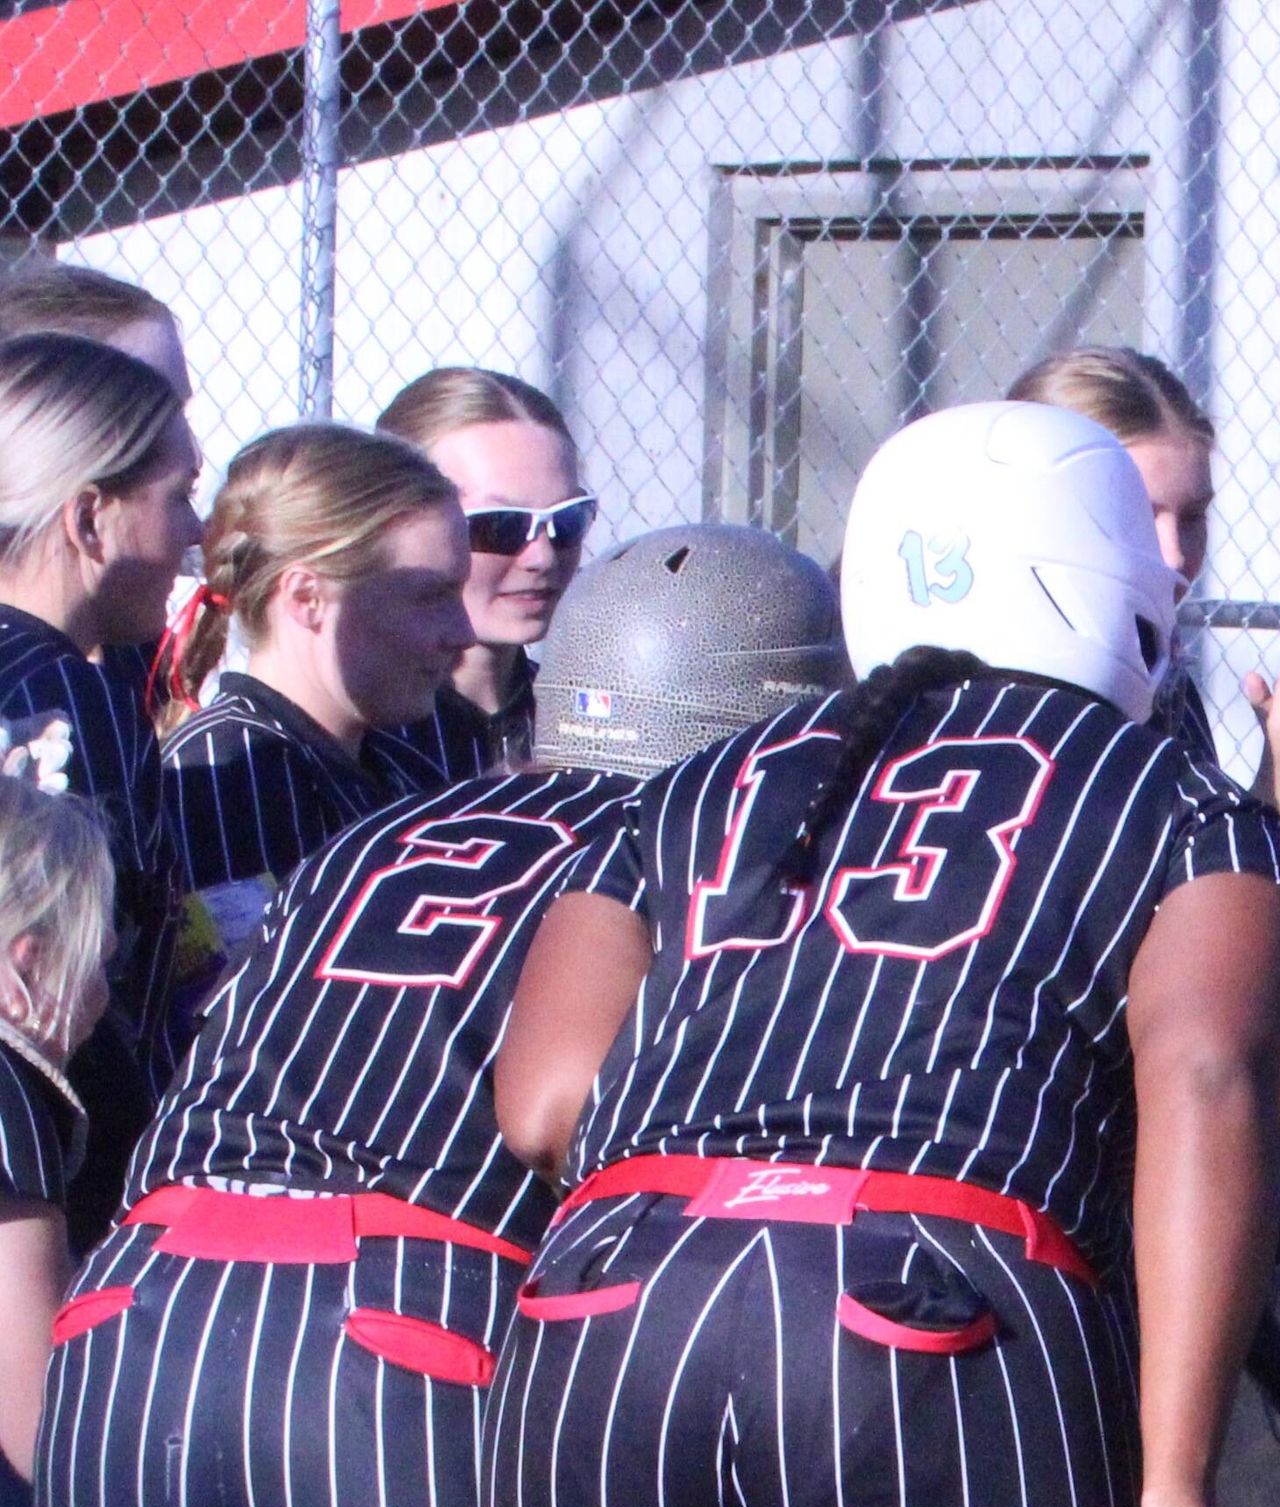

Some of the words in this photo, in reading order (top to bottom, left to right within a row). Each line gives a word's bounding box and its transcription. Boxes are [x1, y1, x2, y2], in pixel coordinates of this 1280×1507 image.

[898, 526, 974, 608] 13
[314, 811, 578, 989] 2
[687, 731, 1056, 961] 13
[724, 1168, 831, 1209] Elusive
